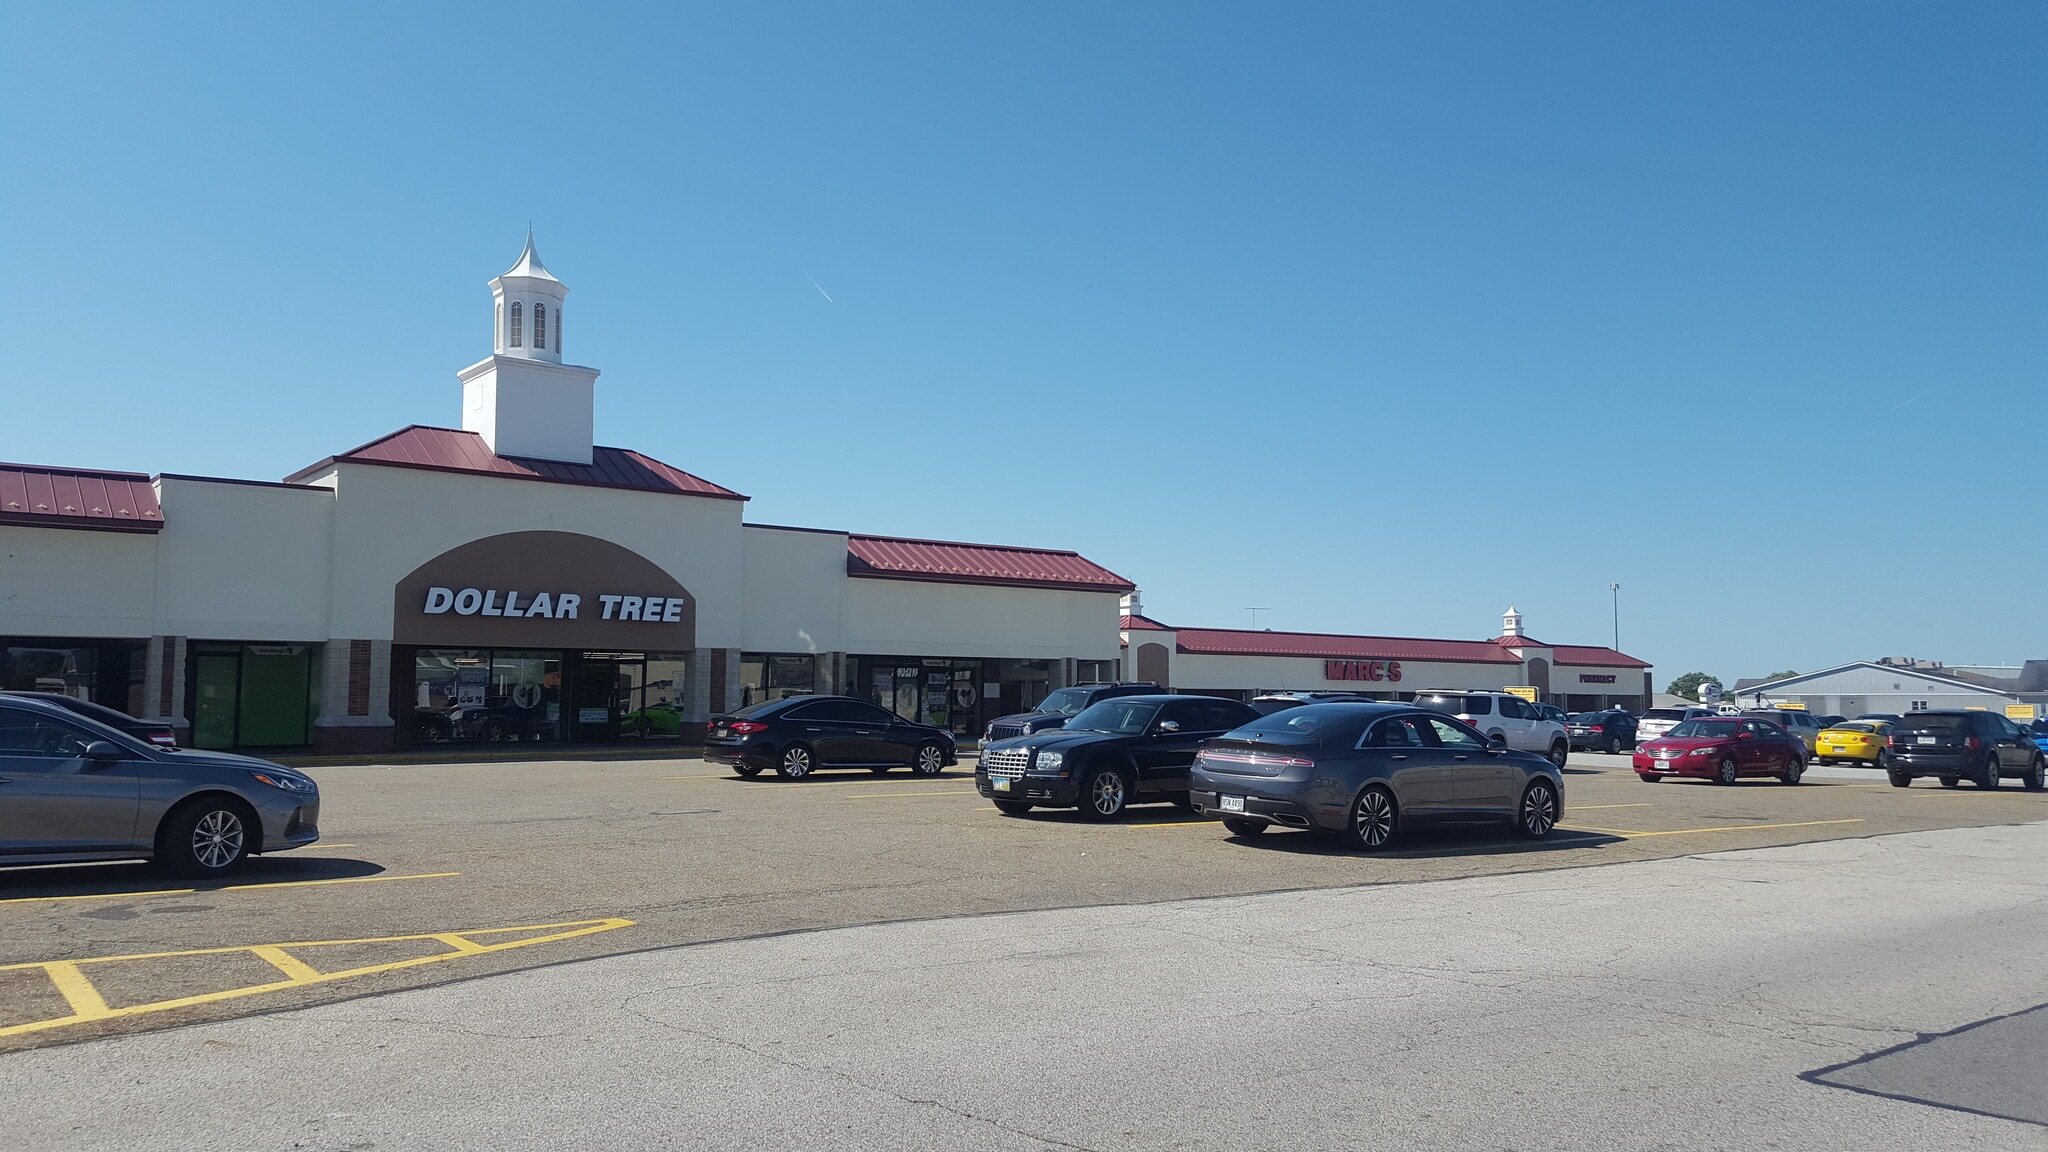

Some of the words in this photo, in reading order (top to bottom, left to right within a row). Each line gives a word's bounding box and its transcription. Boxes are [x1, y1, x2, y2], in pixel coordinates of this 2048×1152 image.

[424, 586, 581, 619] DOLLAR
[598, 594, 684, 622] TREE
[1579, 674, 1616, 683] PHARMACY
